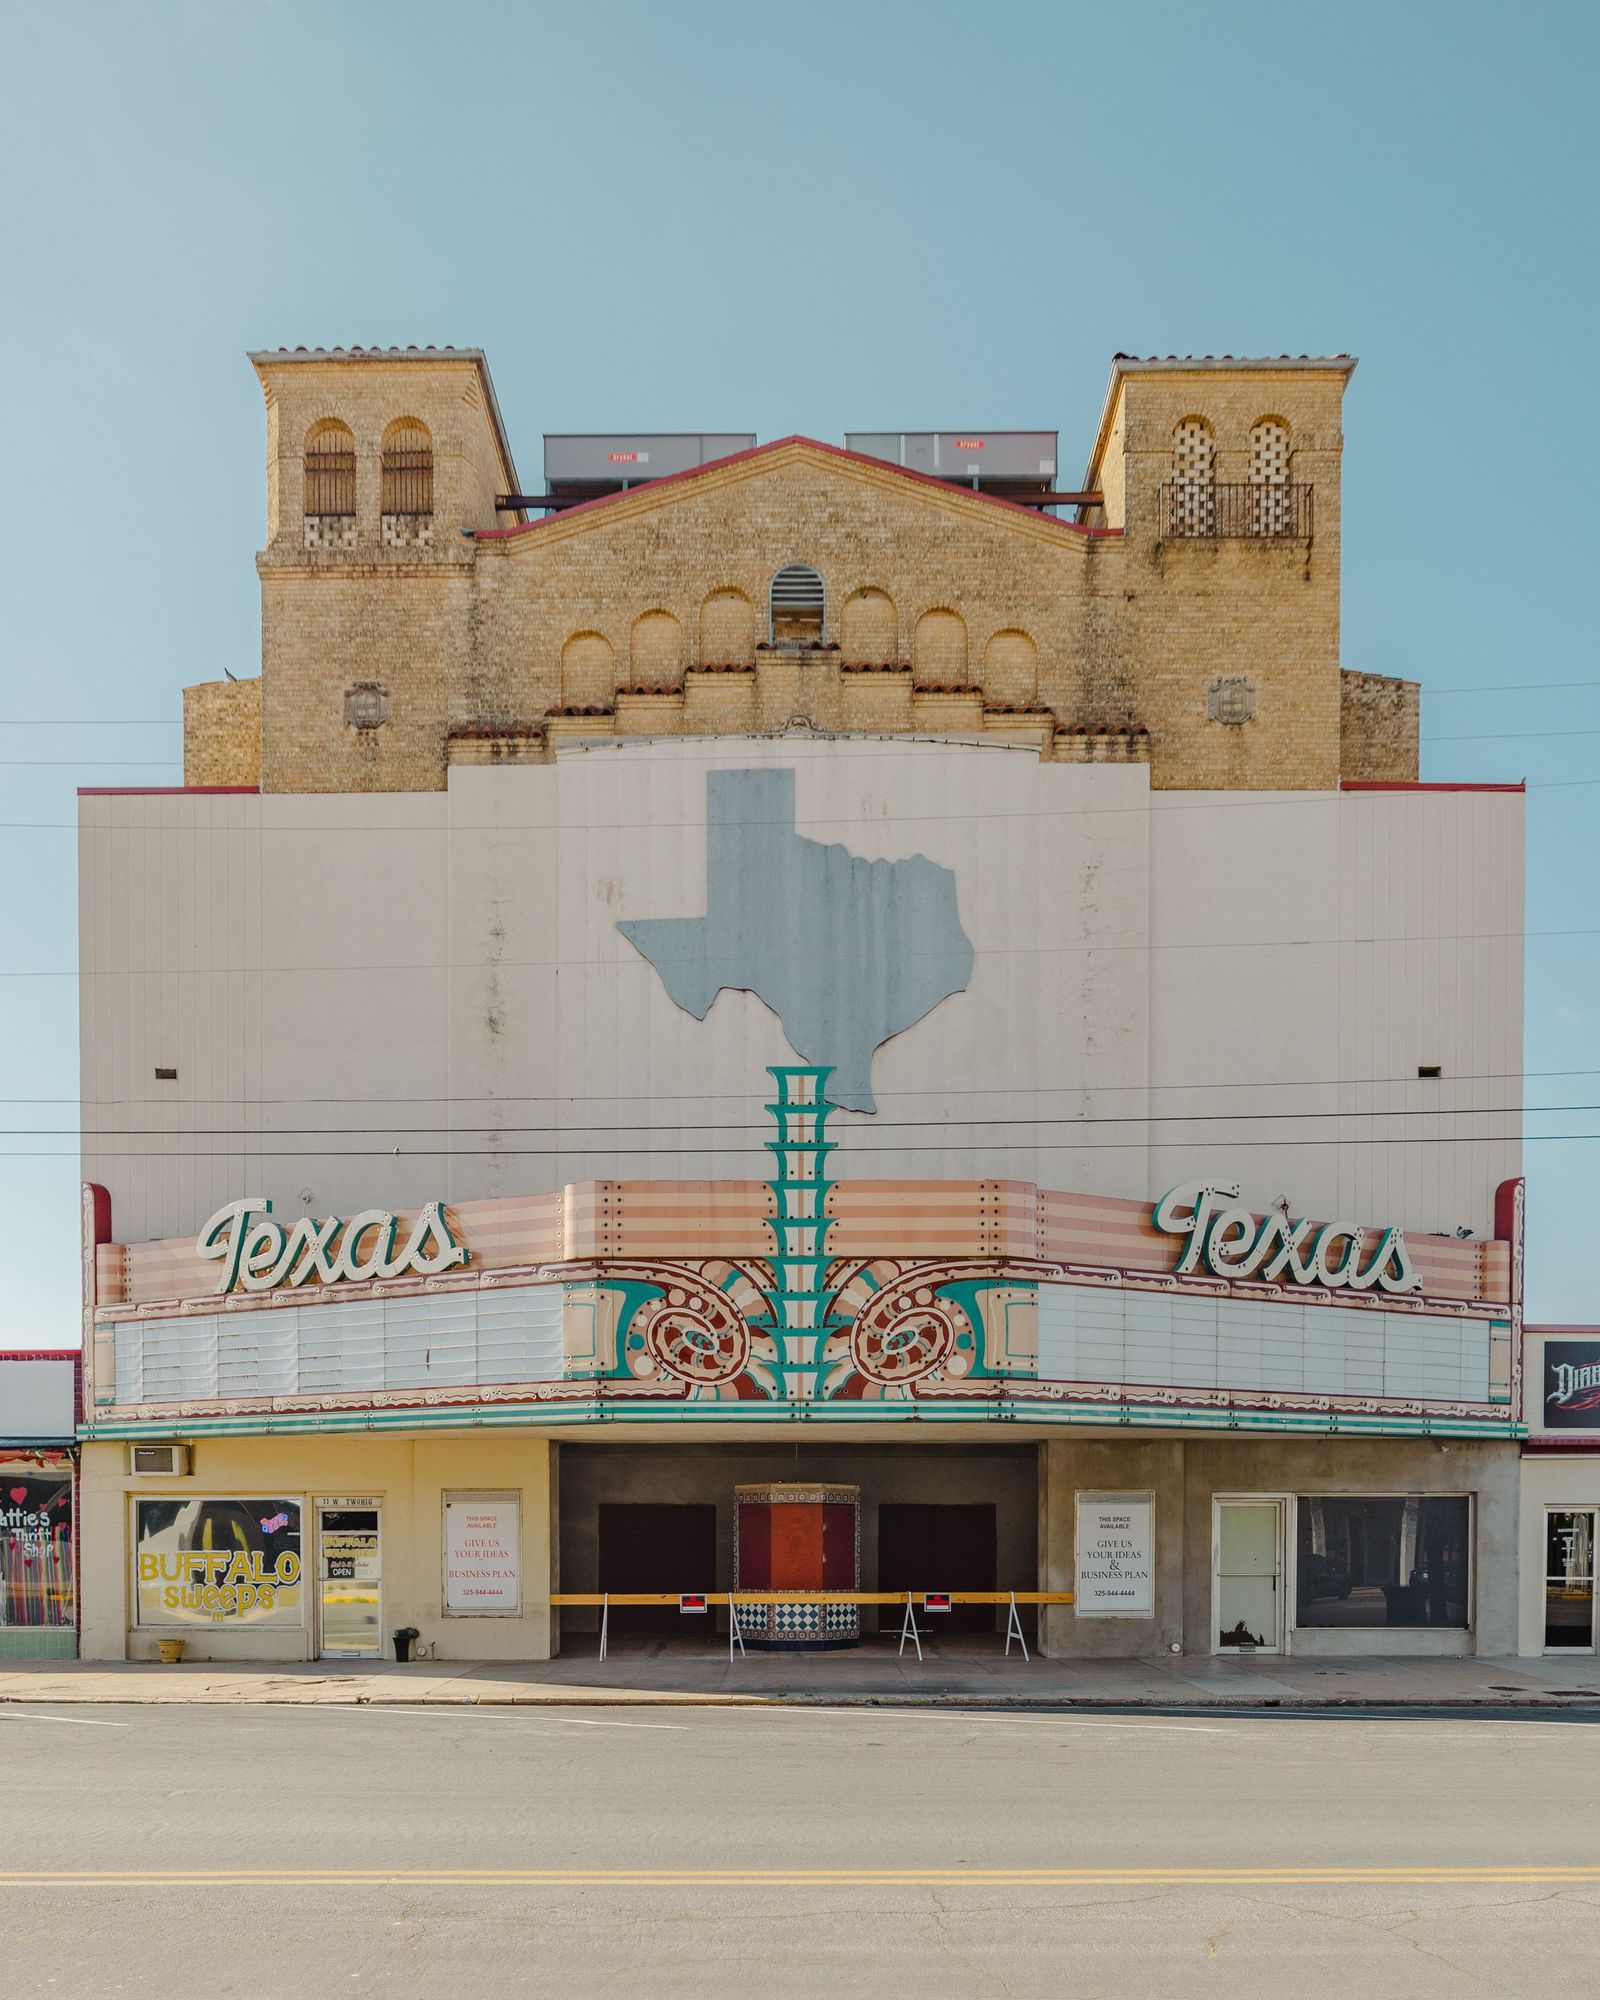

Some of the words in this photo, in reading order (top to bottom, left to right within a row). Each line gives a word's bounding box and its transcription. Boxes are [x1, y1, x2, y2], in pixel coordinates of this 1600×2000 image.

[1153, 1177, 1423, 1293] Texas
[196, 1198, 472, 1294] Texas
[345, 1498, 373, 1506] TWOHIG
[11, 1527, 52, 1542] Thrift
[323, 1536, 377, 1547] BUFFALO
[1097, 1540, 1118, 1548] GIVE
[1121, 1540, 1133, 1548] US
[454, 1550, 481, 1558] YOUR
[483, 1550, 509, 1558] IDEAS
[1087, 1551, 1113, 1559] YOUR
[1115, 1551, 1142, 1559] IDEAS
[138, 1550, 300, 1584] BUFFALO
[1109, 1559, 1120, 1571] &
[332, 1568, 352, 1576] OPEN
[449, 1570, 491, 1578] BUSINESS
[492, 1570, 516, 1578] PLAN
[1081, 1571, 1123, 1579] BUSINESS
[1125, 1571, 1148, 1579] PLAN
